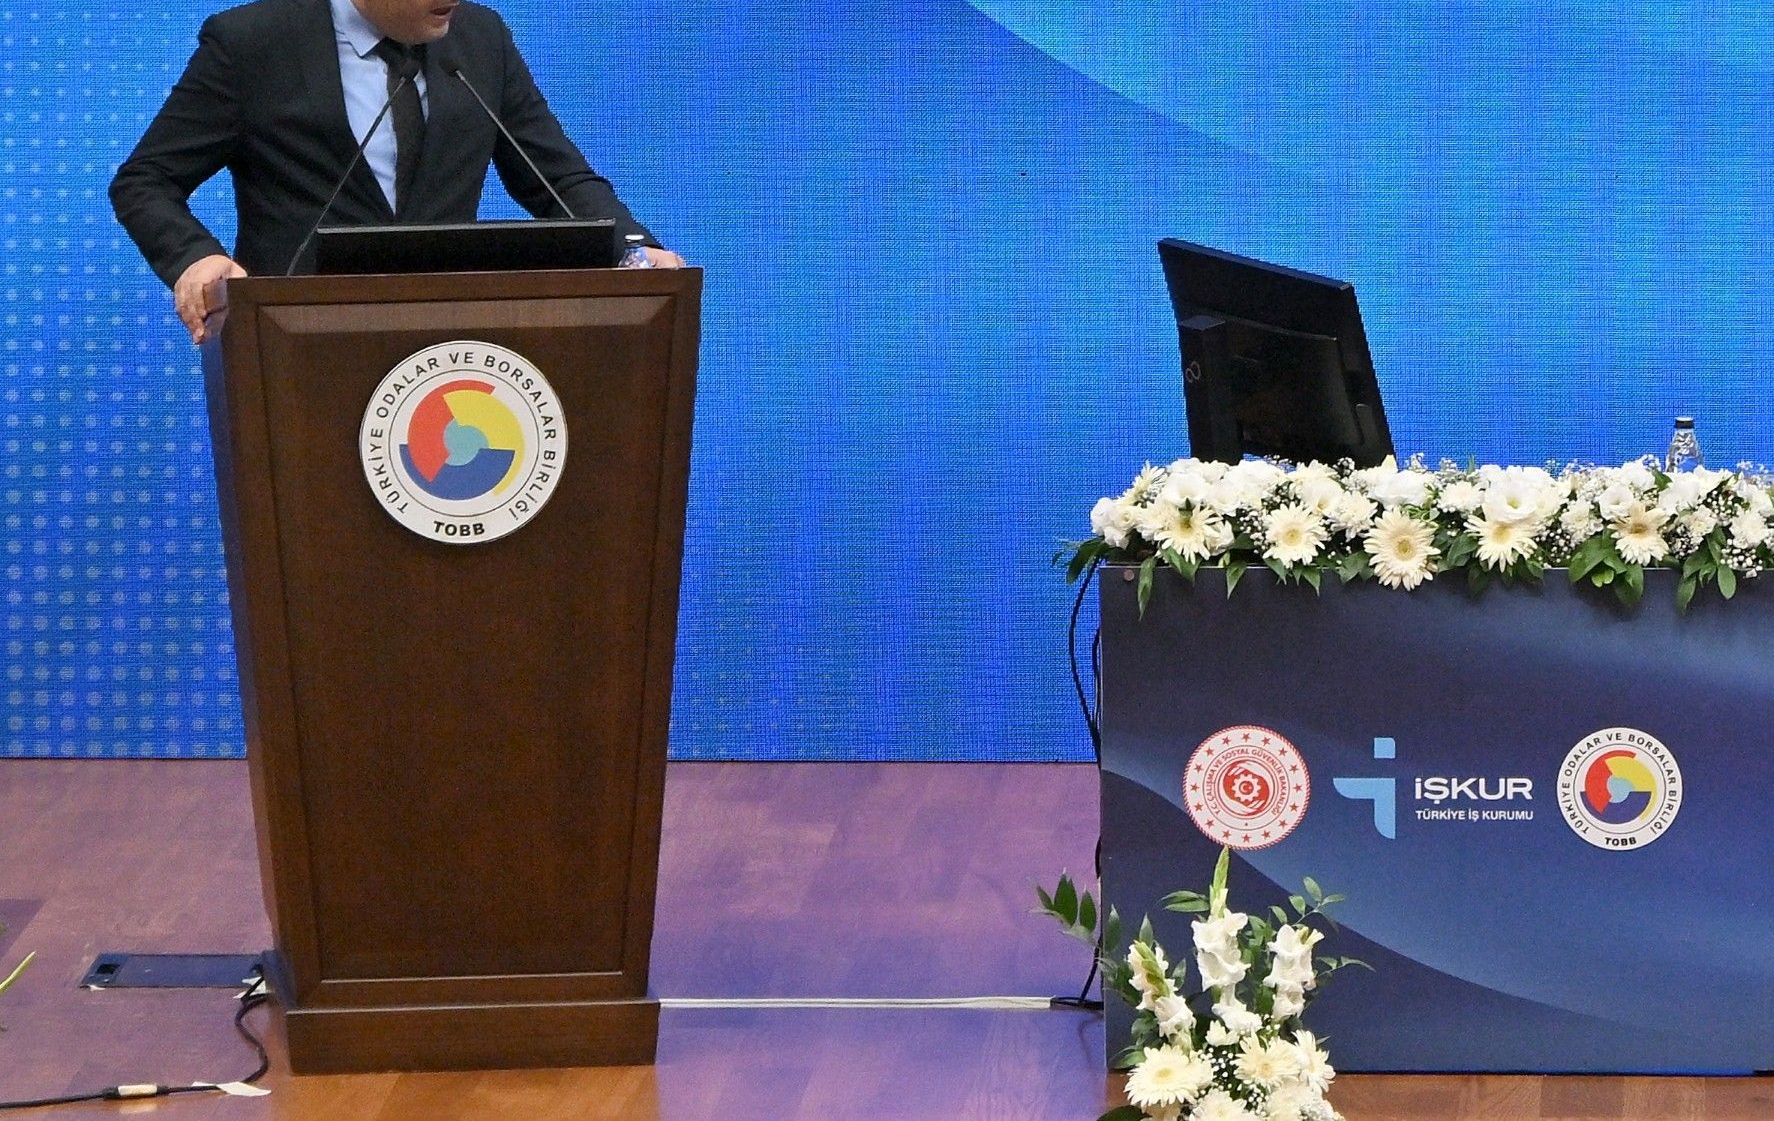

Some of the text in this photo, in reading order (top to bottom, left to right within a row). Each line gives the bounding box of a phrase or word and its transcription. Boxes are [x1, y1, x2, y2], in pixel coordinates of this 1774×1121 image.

[367, 352, 557, 521] TÜRKİYE ODALAR VE BORSALAR BİRLİĞİ
[433, 520, 486, 537] TOBB
[1564, 737, 1601, 777] ODALAR
[1606, 732, 1622, 741] VE
[1628, 734, 1676, 784] BORSALAR
[1415, 808, 1534, 822] TÜRKİYE İŞ KURUMU
[1605, 837, 1637, 846] TOBB
